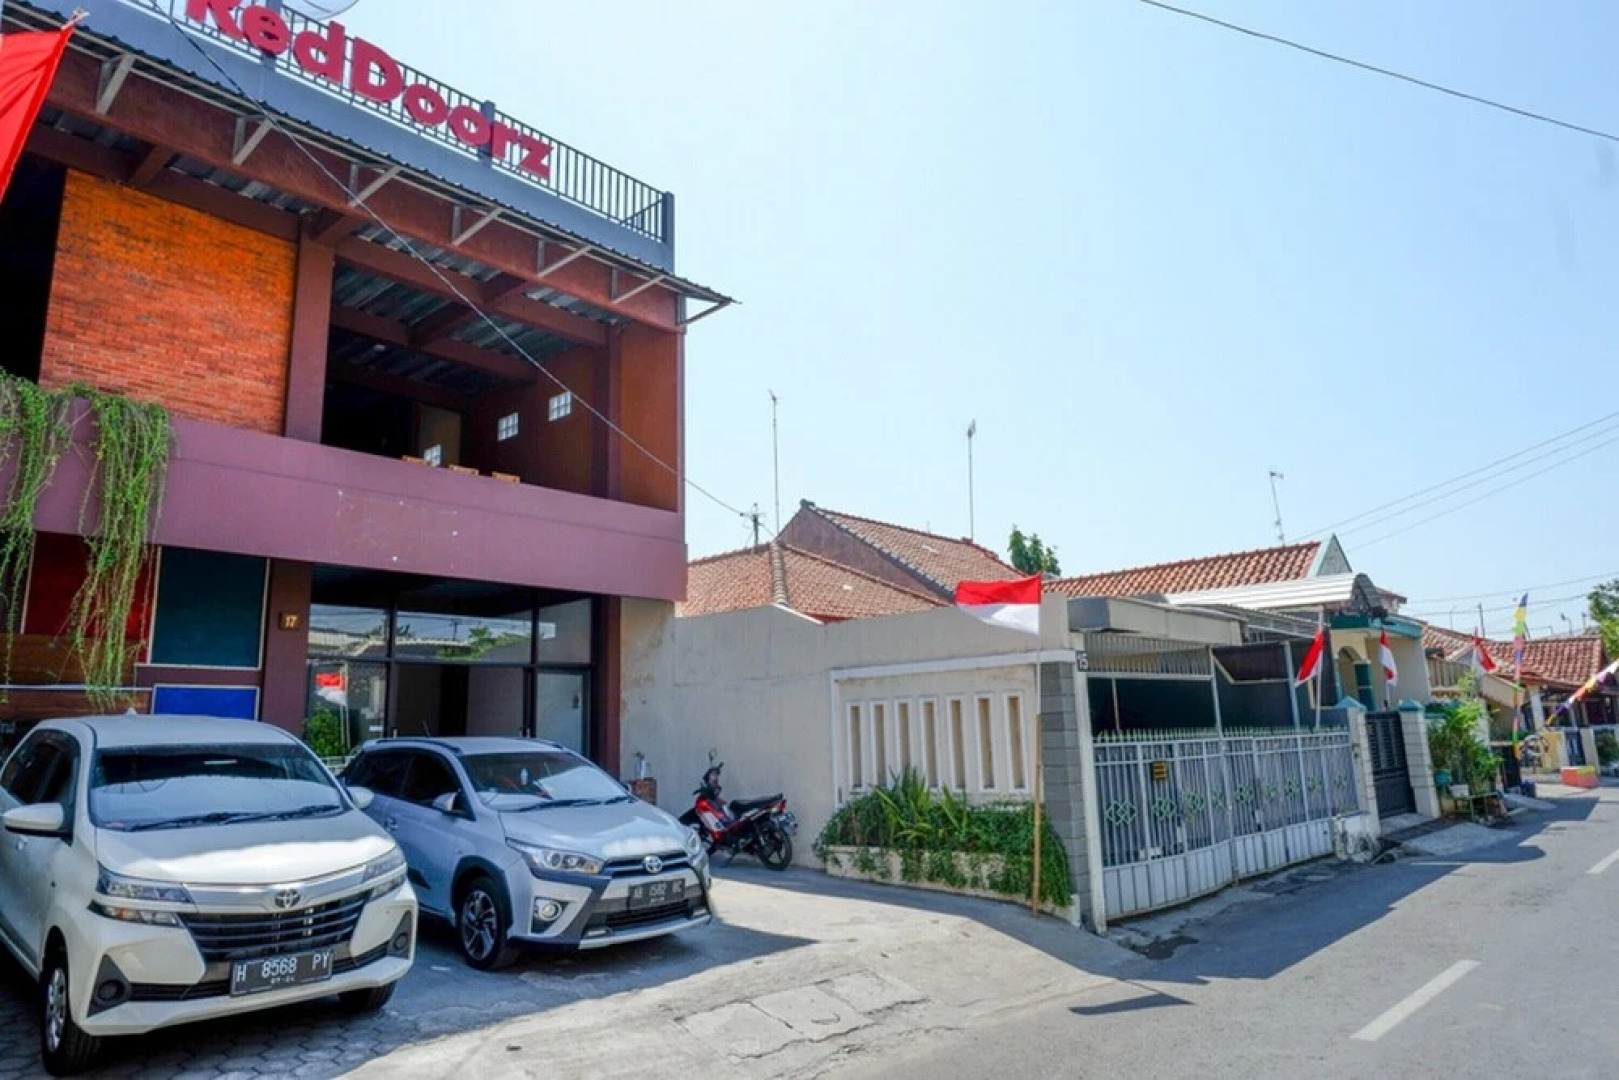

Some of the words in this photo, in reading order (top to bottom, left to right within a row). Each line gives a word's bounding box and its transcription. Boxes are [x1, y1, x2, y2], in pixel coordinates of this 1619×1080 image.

[284, 616, 297, 628] 17
[236, 964, 247, 982] H
[261, 956, 297, 979] 8568
[312, 952, 330, 971] PY
